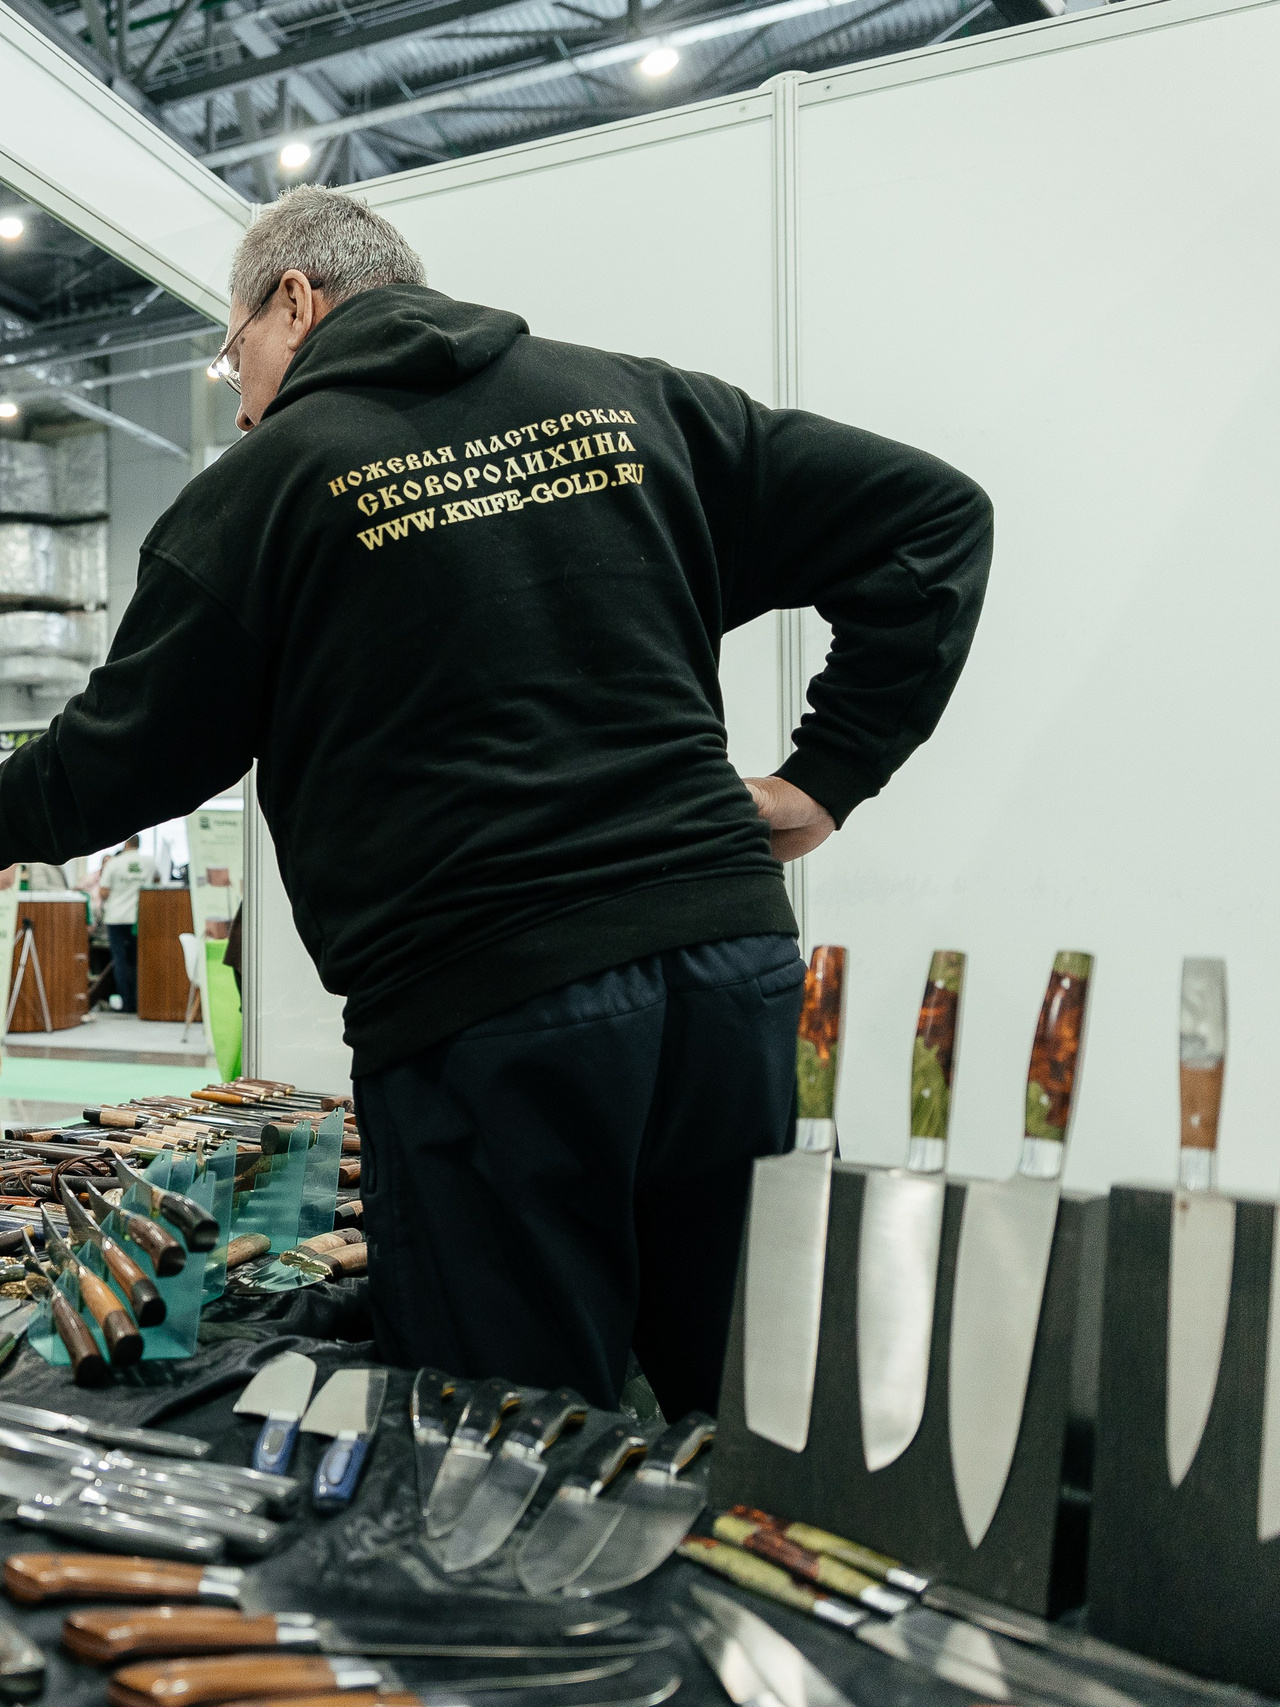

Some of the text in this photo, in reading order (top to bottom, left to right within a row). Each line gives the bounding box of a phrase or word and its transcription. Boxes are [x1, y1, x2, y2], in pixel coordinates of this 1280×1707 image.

[327, 408, 638, 497] НОЖЕВАЯ МАСТЕРСКАЯ
[357, 431, 637, 517] СКОВОРОДИХИНА
